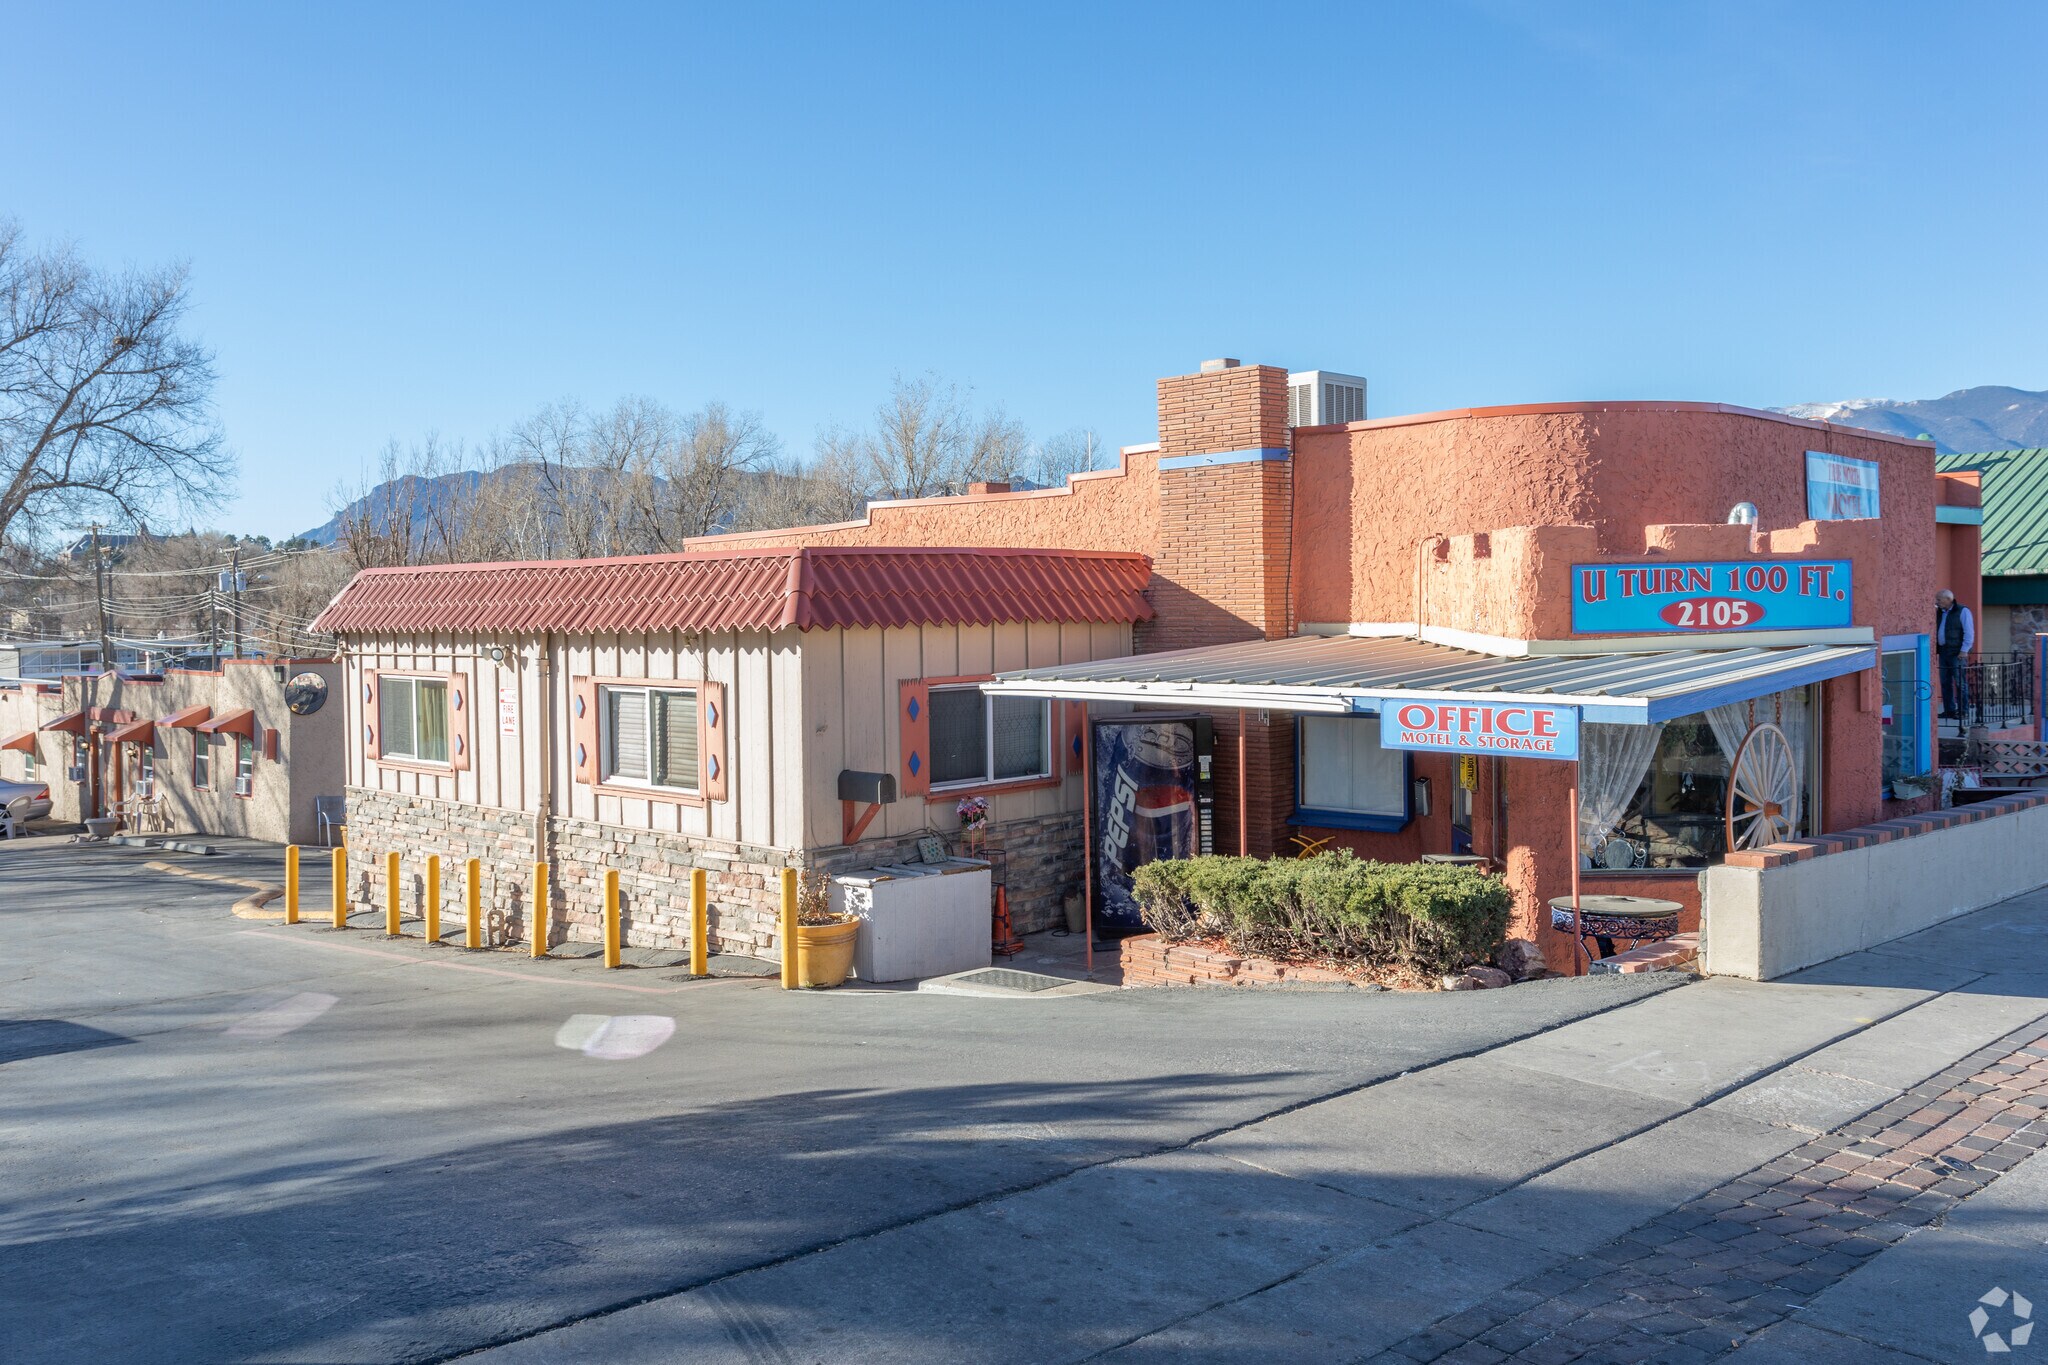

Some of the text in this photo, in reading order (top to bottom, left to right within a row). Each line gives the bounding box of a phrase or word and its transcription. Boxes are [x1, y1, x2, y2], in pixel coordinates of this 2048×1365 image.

[1581, 564, 1845, 603] U TURN 100 FT.
[1678, 601, 1749, 626] 2105
[501, 716, 515, 725] LANE
[502, 704, 514, 714] FIRE
[1397, 704, 1559, 737] OFFICE
[1400, 732, 1555, 751] MOTEL & STORAGE
[1103, 764, 1139, 869] PEPSI
